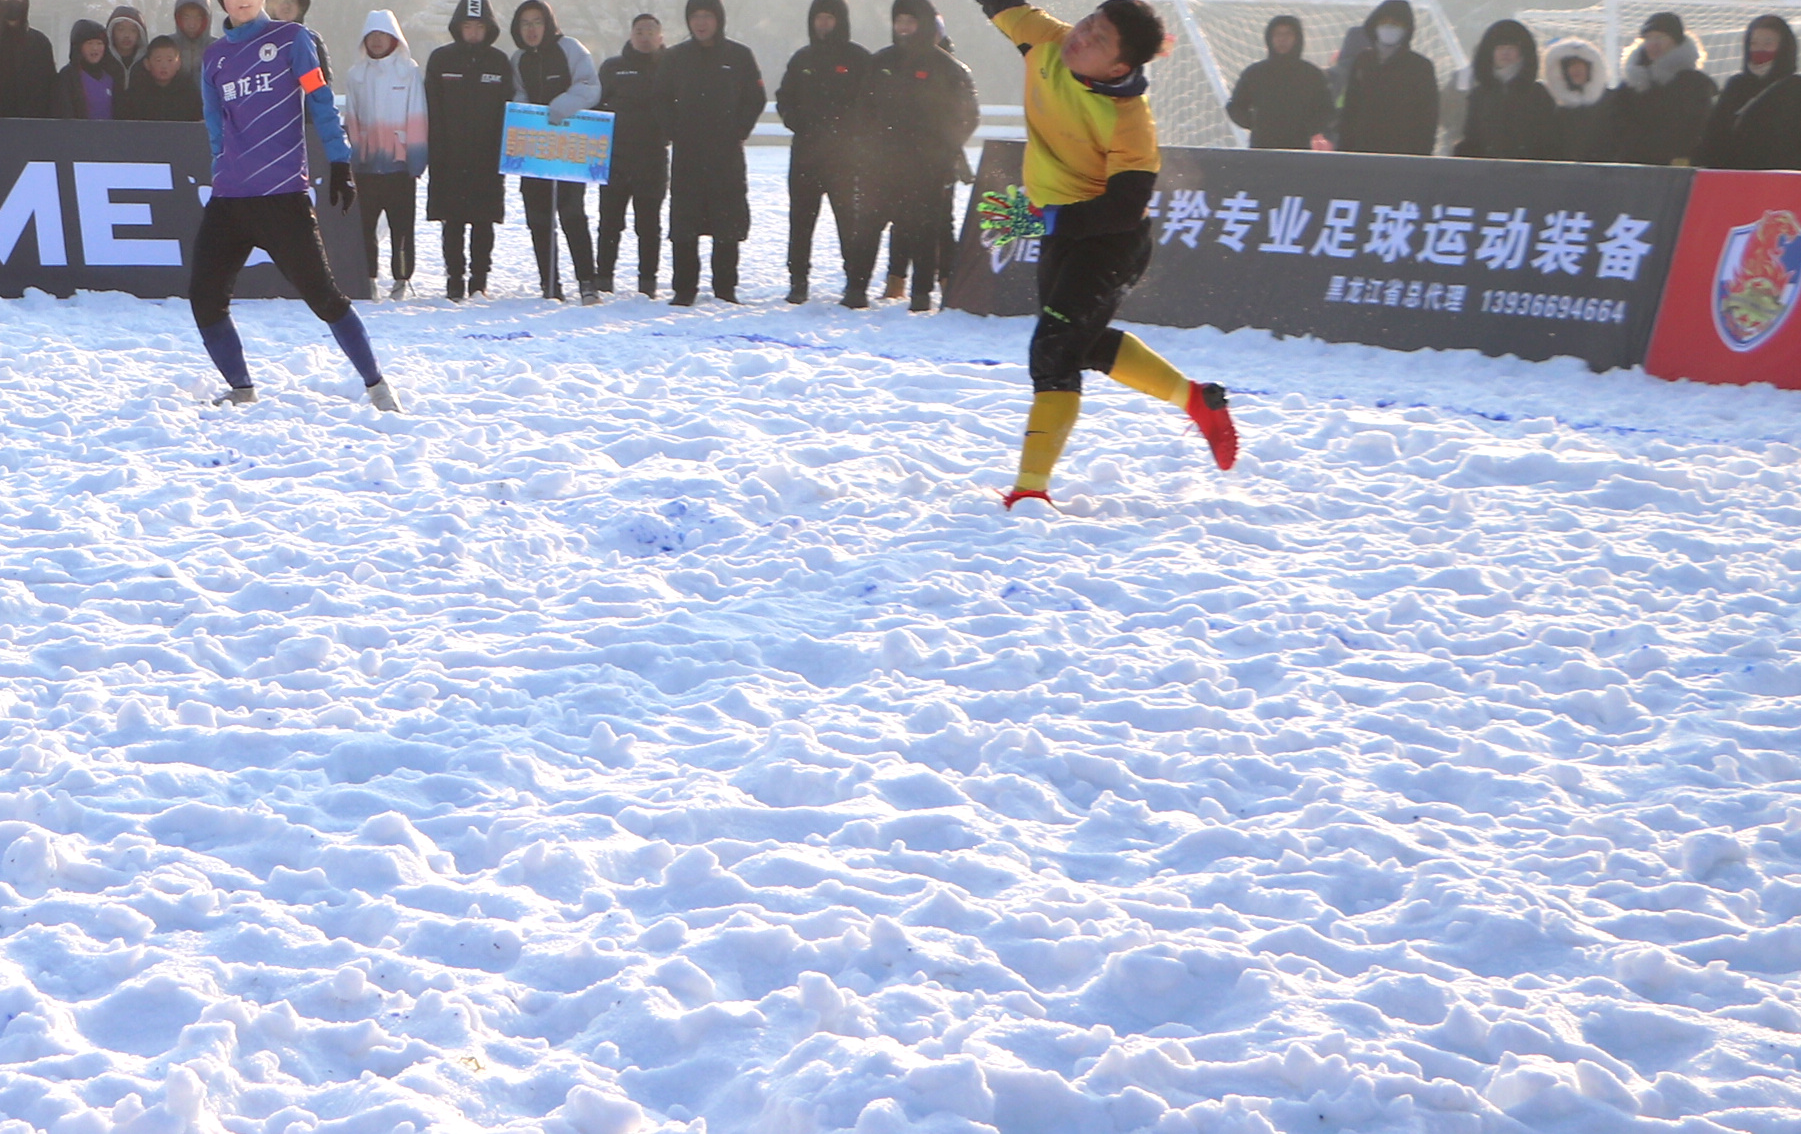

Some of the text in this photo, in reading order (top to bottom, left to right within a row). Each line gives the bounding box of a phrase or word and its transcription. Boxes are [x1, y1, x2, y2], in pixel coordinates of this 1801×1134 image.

[222, 72, 274, 102] 黑龙江
[1148, 188, 1653, 282] 羚专业足球运动装备
[1324, 274, 1627, 324] 黑龙江省总代理 13936694664
